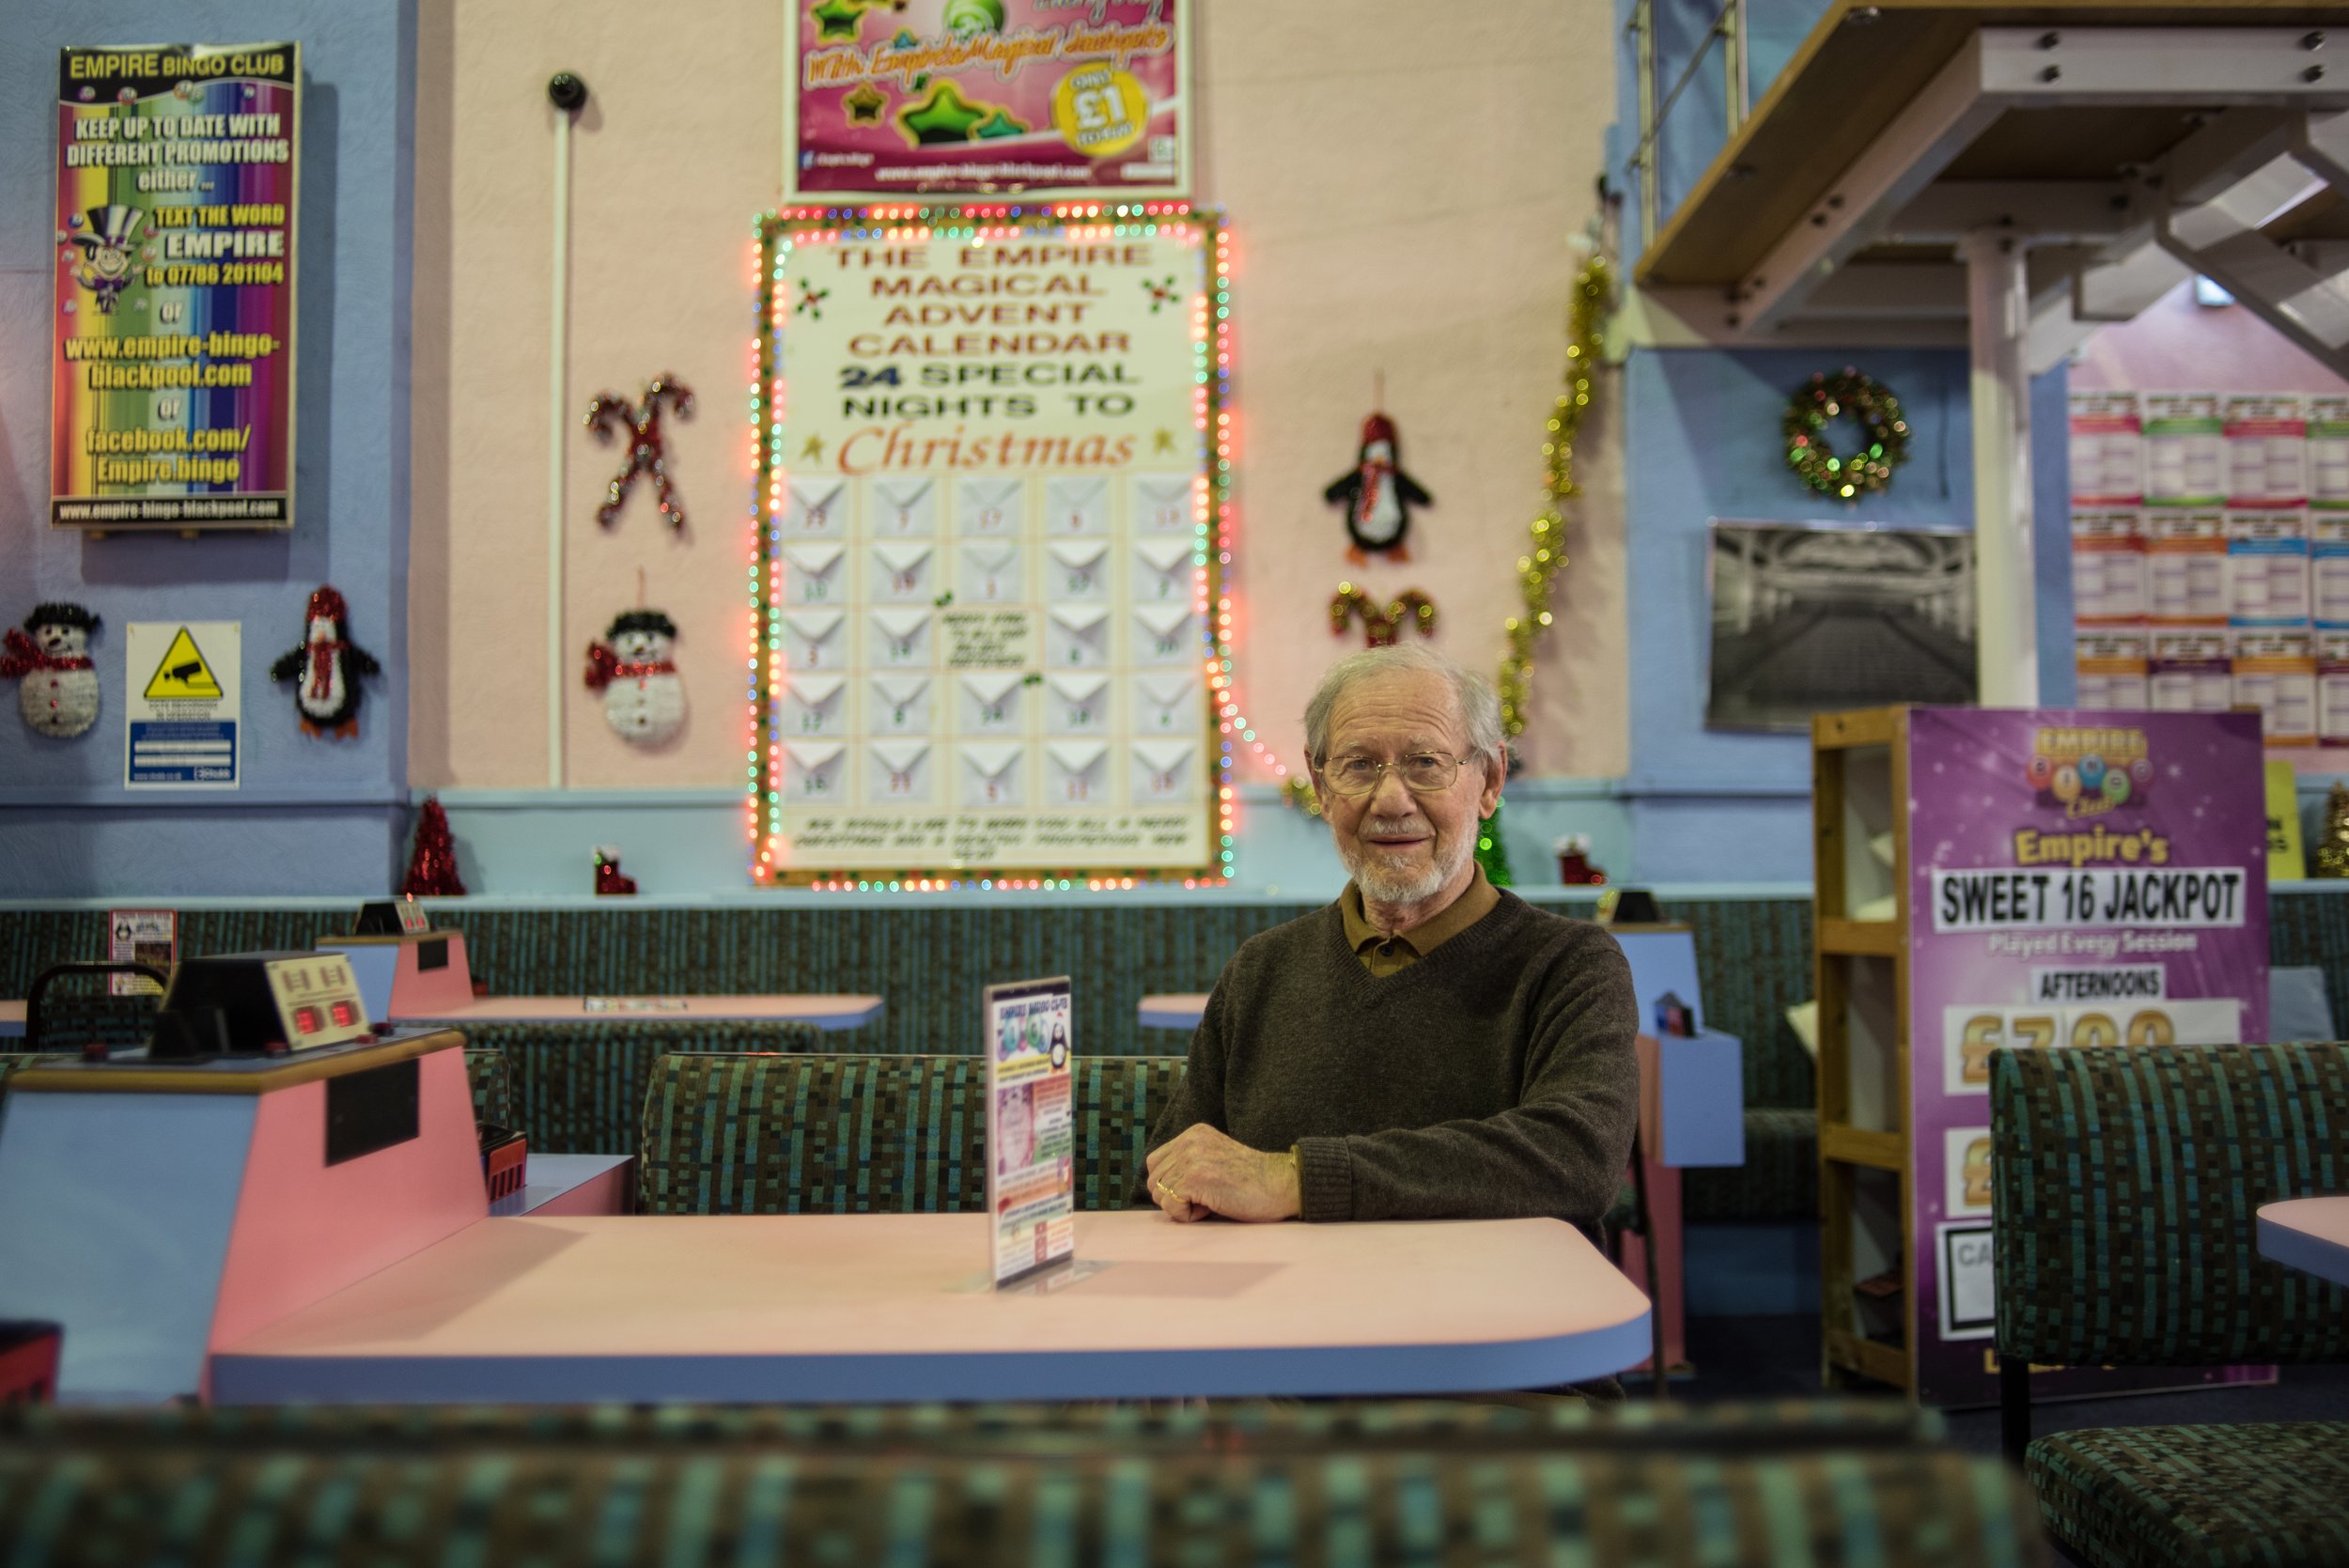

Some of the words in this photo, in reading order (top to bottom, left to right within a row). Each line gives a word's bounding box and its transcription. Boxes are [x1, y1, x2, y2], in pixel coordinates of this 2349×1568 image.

[70, 54, 159, 78] EMPIRE
[163, 55, 226, 76] BINGO
[231, 54, 284, 75] CLUB
[1075, 86, 1124, 126] £1
[75, 117, 120, 140] KEEP
[122, 116, 148, 139] UP
[151, 115, 176, 138] TO
[179, 114, 226, 137] DATE
[228, 113, 281, 136] WITH
[67, 143, 160, 167] DIFFERENT
[164, 139, 289, 163] PROMOTIONS
[137, 168, 197, 193] either
[154, 206, 194, 226] TEXT
[198, 206, 227, 225] THE
[231, 204, 285, 225] WORD
[165, 230, 285, 259] EMPIRE
[834, 244, 929, 270] THE
[957, 243, 1153, 269] EMPIRE
[145, 264, 164, 286] to
[222, 261, 284, 285] 201104
[872, 273, 1107, 299] MAGICAL
[161, 301, 183, 323] or
[883, 303, 1093, 328] ADVENT
[64, 331, 280, 360] www.empire-bingo-
[848, 332, 1130, 358] CALENDAR
[89, 362, 252, 390] blackpool.com
[839, 366, 902, 390] 24
[921, 363, 1142, 386] SPECIAL
[159, 397, 182, 421] or
[841, 394, 1035, 420] NIGHTS
[1066, 393, 1135, 416] TO
[86, 424, 251, 454] facebook.com/
[837, 419, 1137, 476] Christmas
[2015, 824, 2170, 868] Empire's
[1942, 873, 2050, 924] SWEET
[2061, 875, 2095, 921] 16
[2104, 873, 2240, 921] JACKPOT
[1989, 930, 2057, 958] Played
[2063, 931, 2120, 958] Every
[2123, 928, 2198, 954] Session
[2040, 969, 2160, 1000] AFTERNOONS
